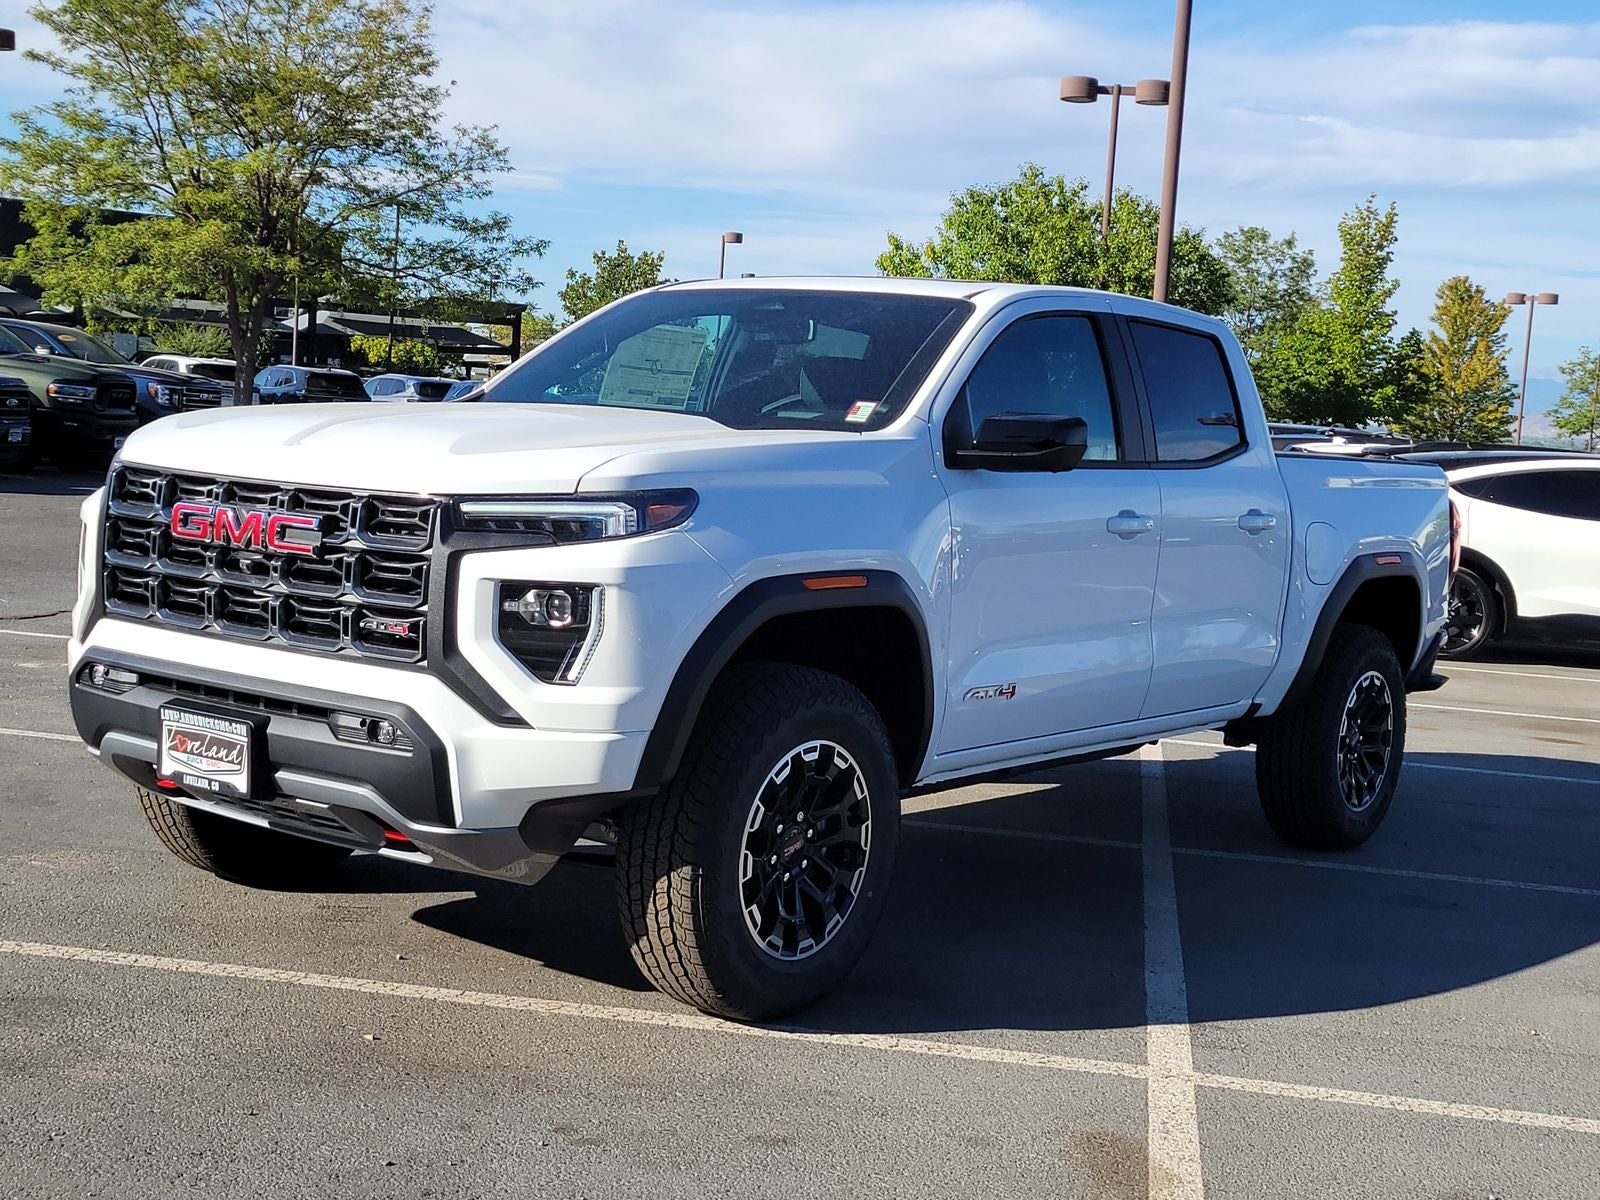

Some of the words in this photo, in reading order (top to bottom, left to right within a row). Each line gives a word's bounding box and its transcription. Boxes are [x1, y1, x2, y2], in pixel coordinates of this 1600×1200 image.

[171, 501, 321, 557] GMC
[963, 683, 1016, 701] AT4
[161, 708, 247, 736] LOVELANDBUICKGMC.COM
[206, 760, 221, 768] GMC
